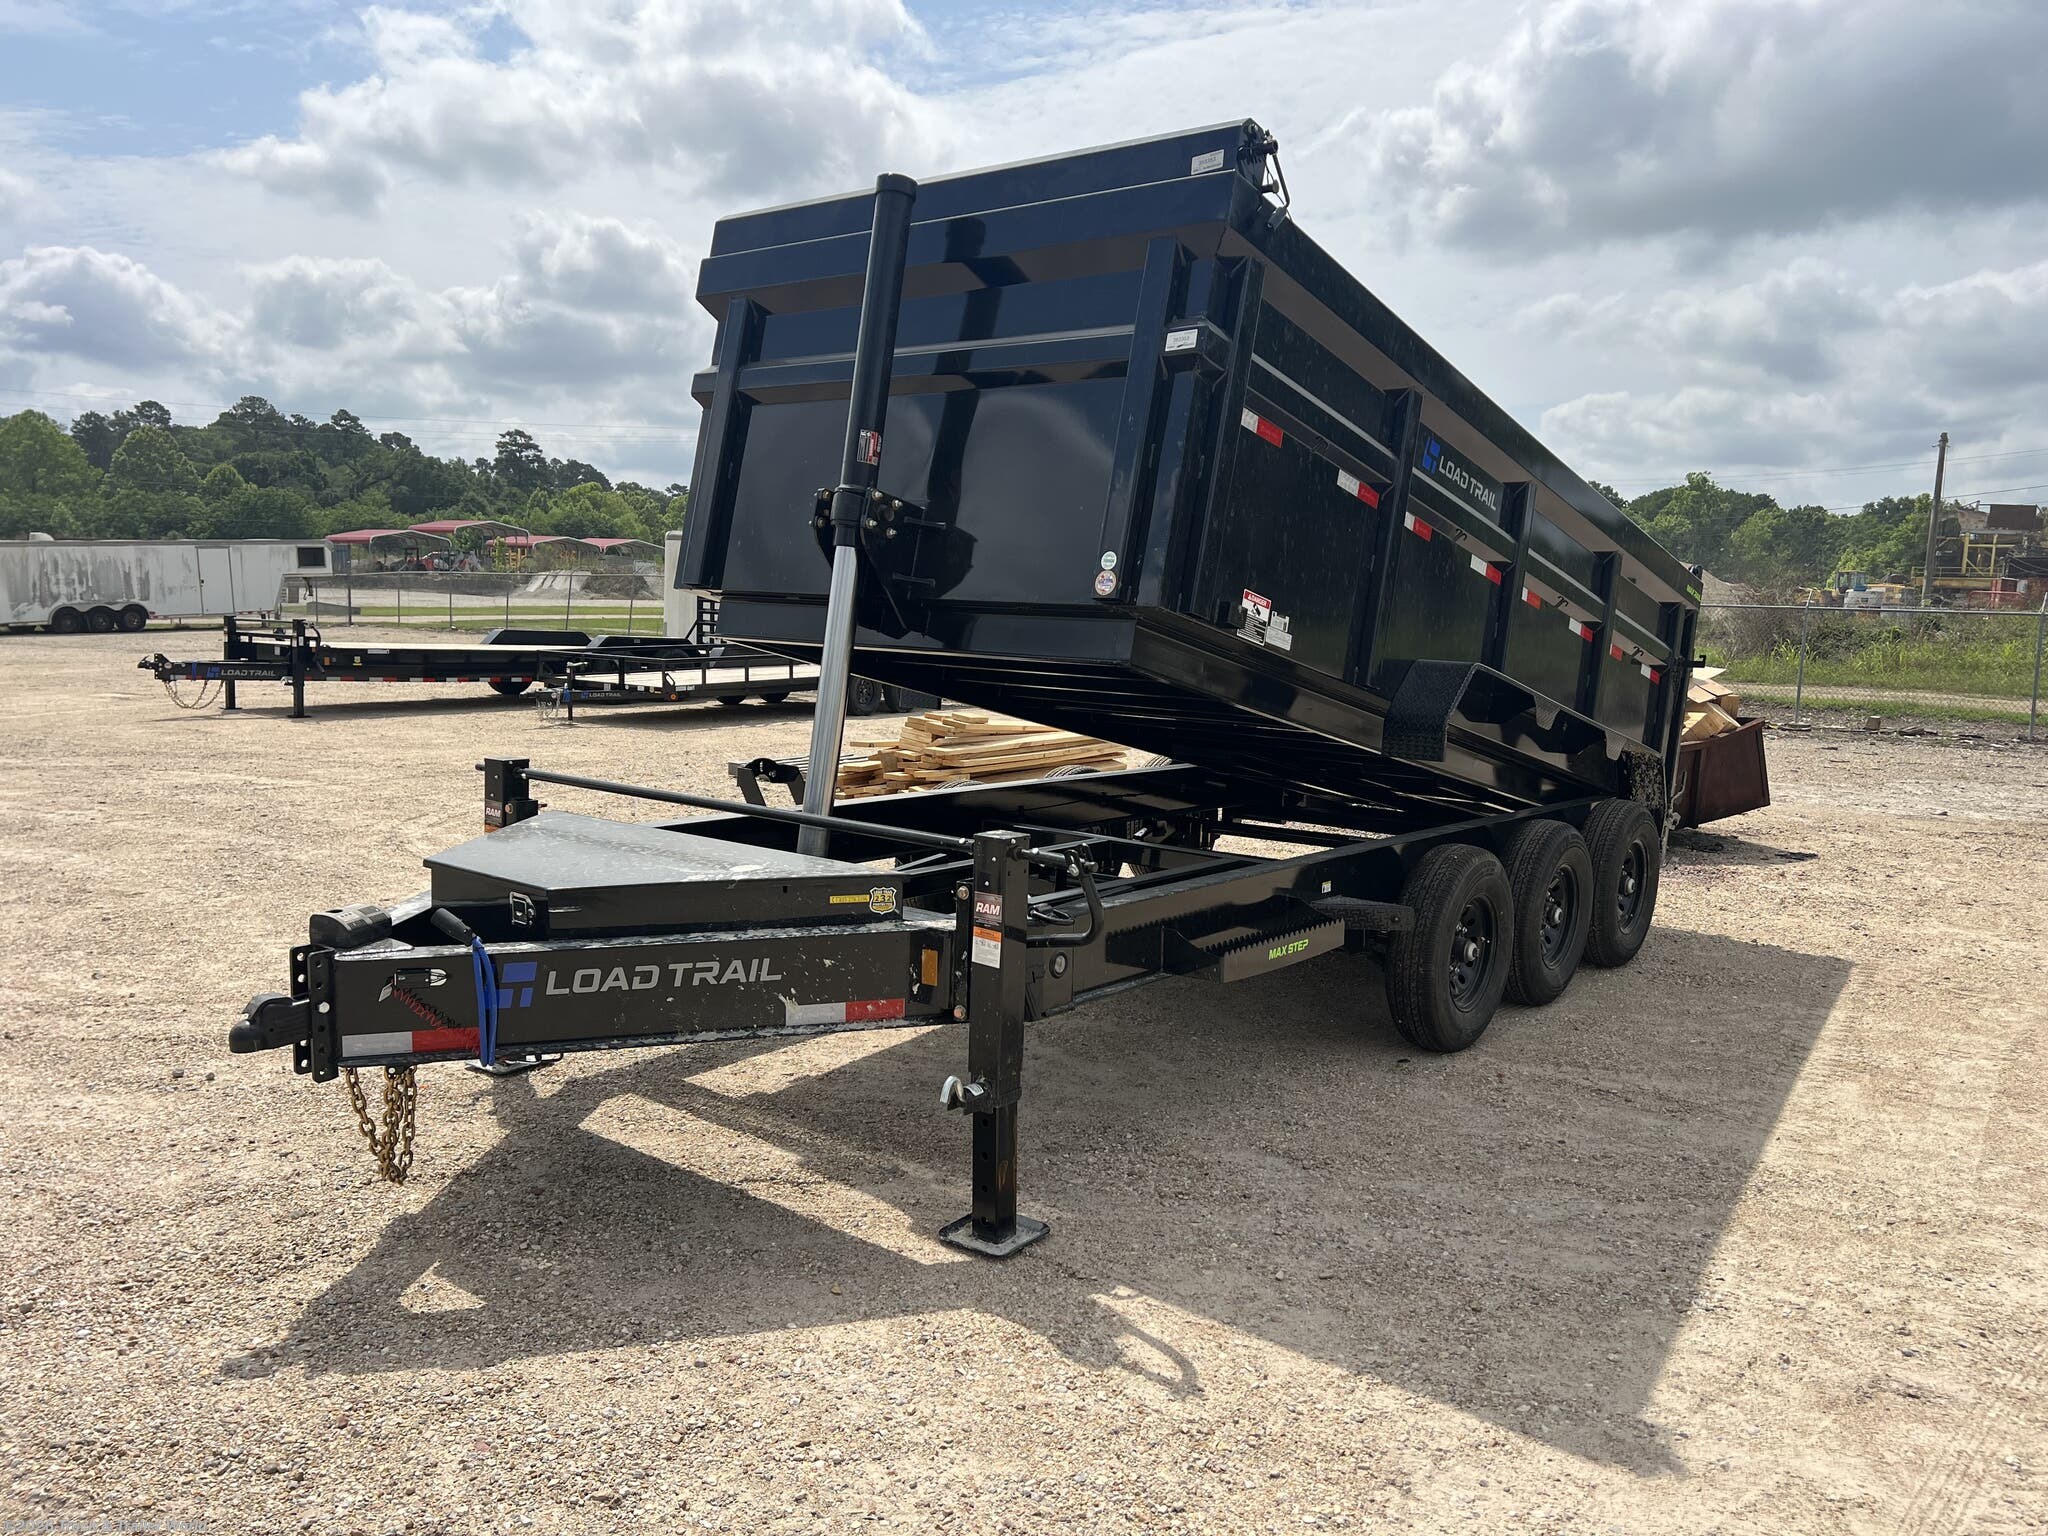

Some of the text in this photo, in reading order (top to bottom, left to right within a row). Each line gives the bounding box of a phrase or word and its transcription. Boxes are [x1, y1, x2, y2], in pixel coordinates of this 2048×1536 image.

[1439, 455, 1497, 511] LOAD TRAIL
[221, 669, 277, 677] LOAD TRAIL
[485, 806, 502, 818] RAM
[975, 901, 1001, 916] RAM
[1268, 938, 1309, 961] MAX STEP
[545, 957, 783, 996] LOAD TRAIL
